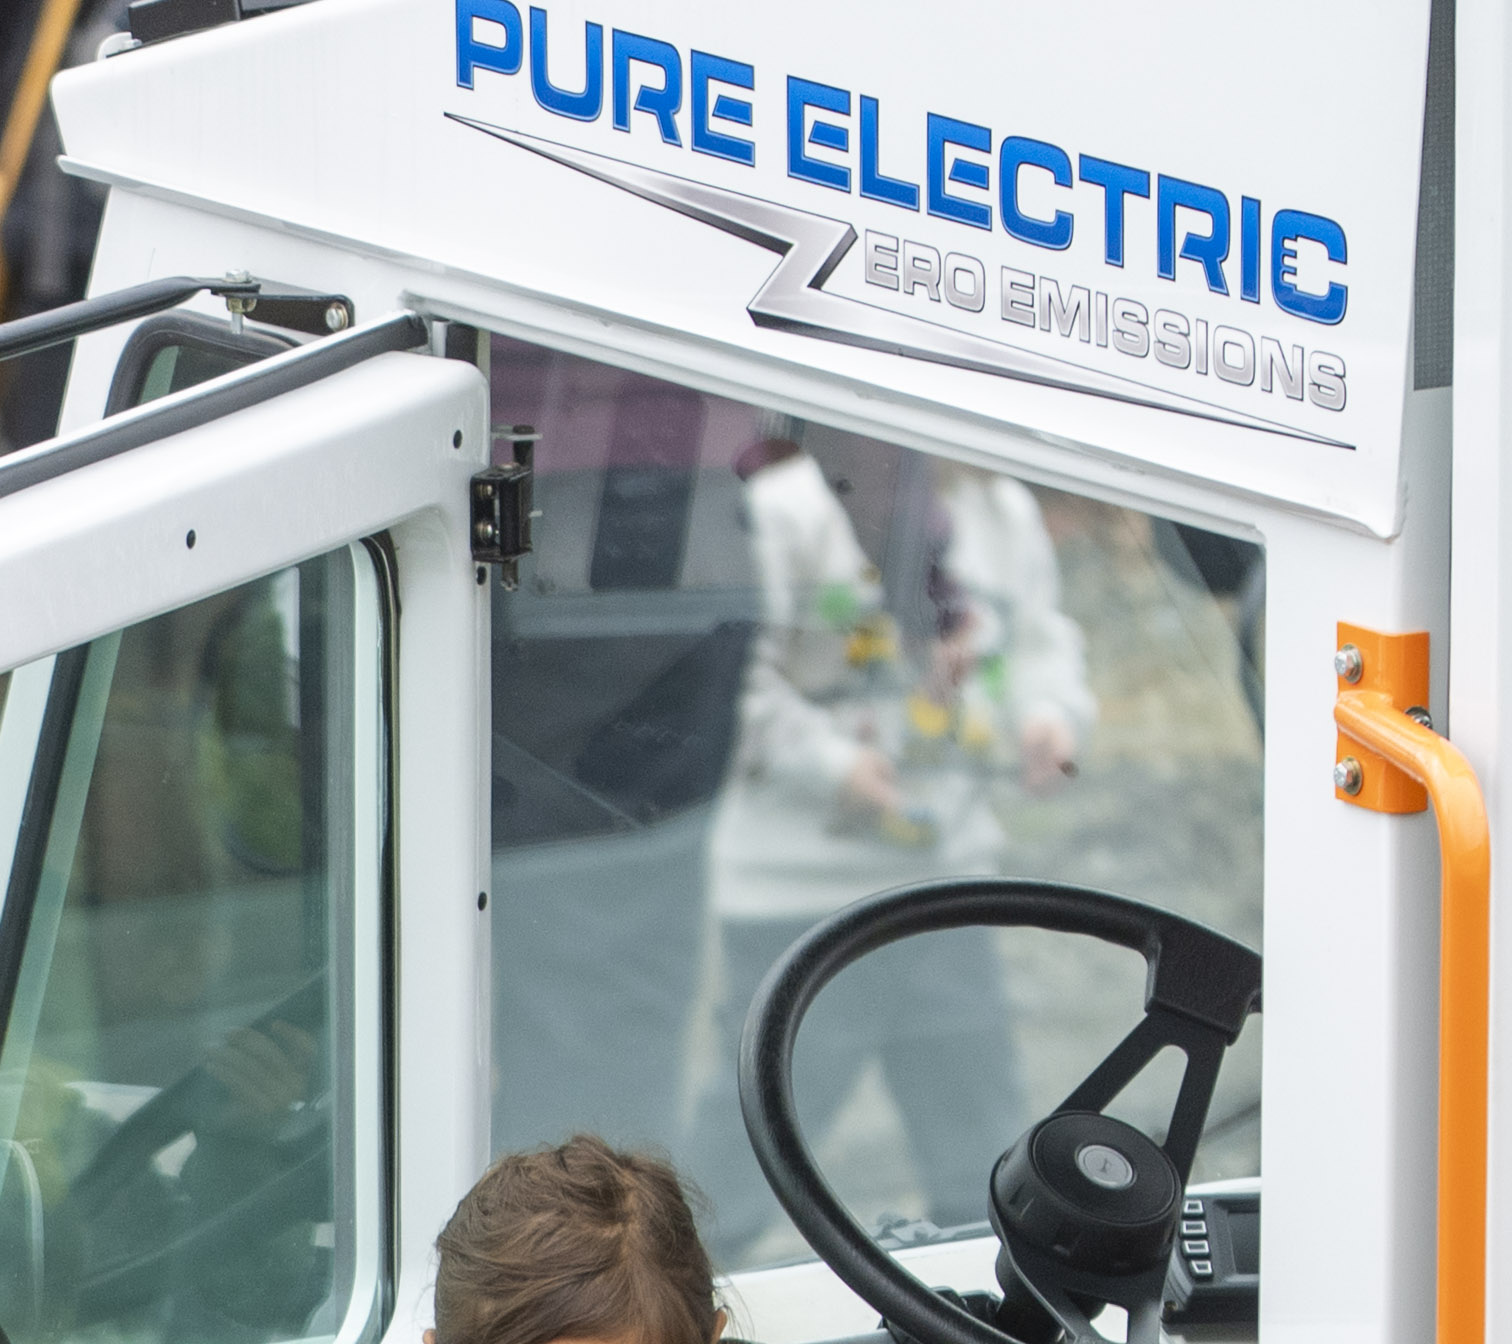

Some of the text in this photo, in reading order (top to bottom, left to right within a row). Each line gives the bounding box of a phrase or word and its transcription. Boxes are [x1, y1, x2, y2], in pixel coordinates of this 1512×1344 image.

[455, 0, 1349, 325] PURE ELECTRIC
[999, 268, 1347, 412] EMISSIONS
